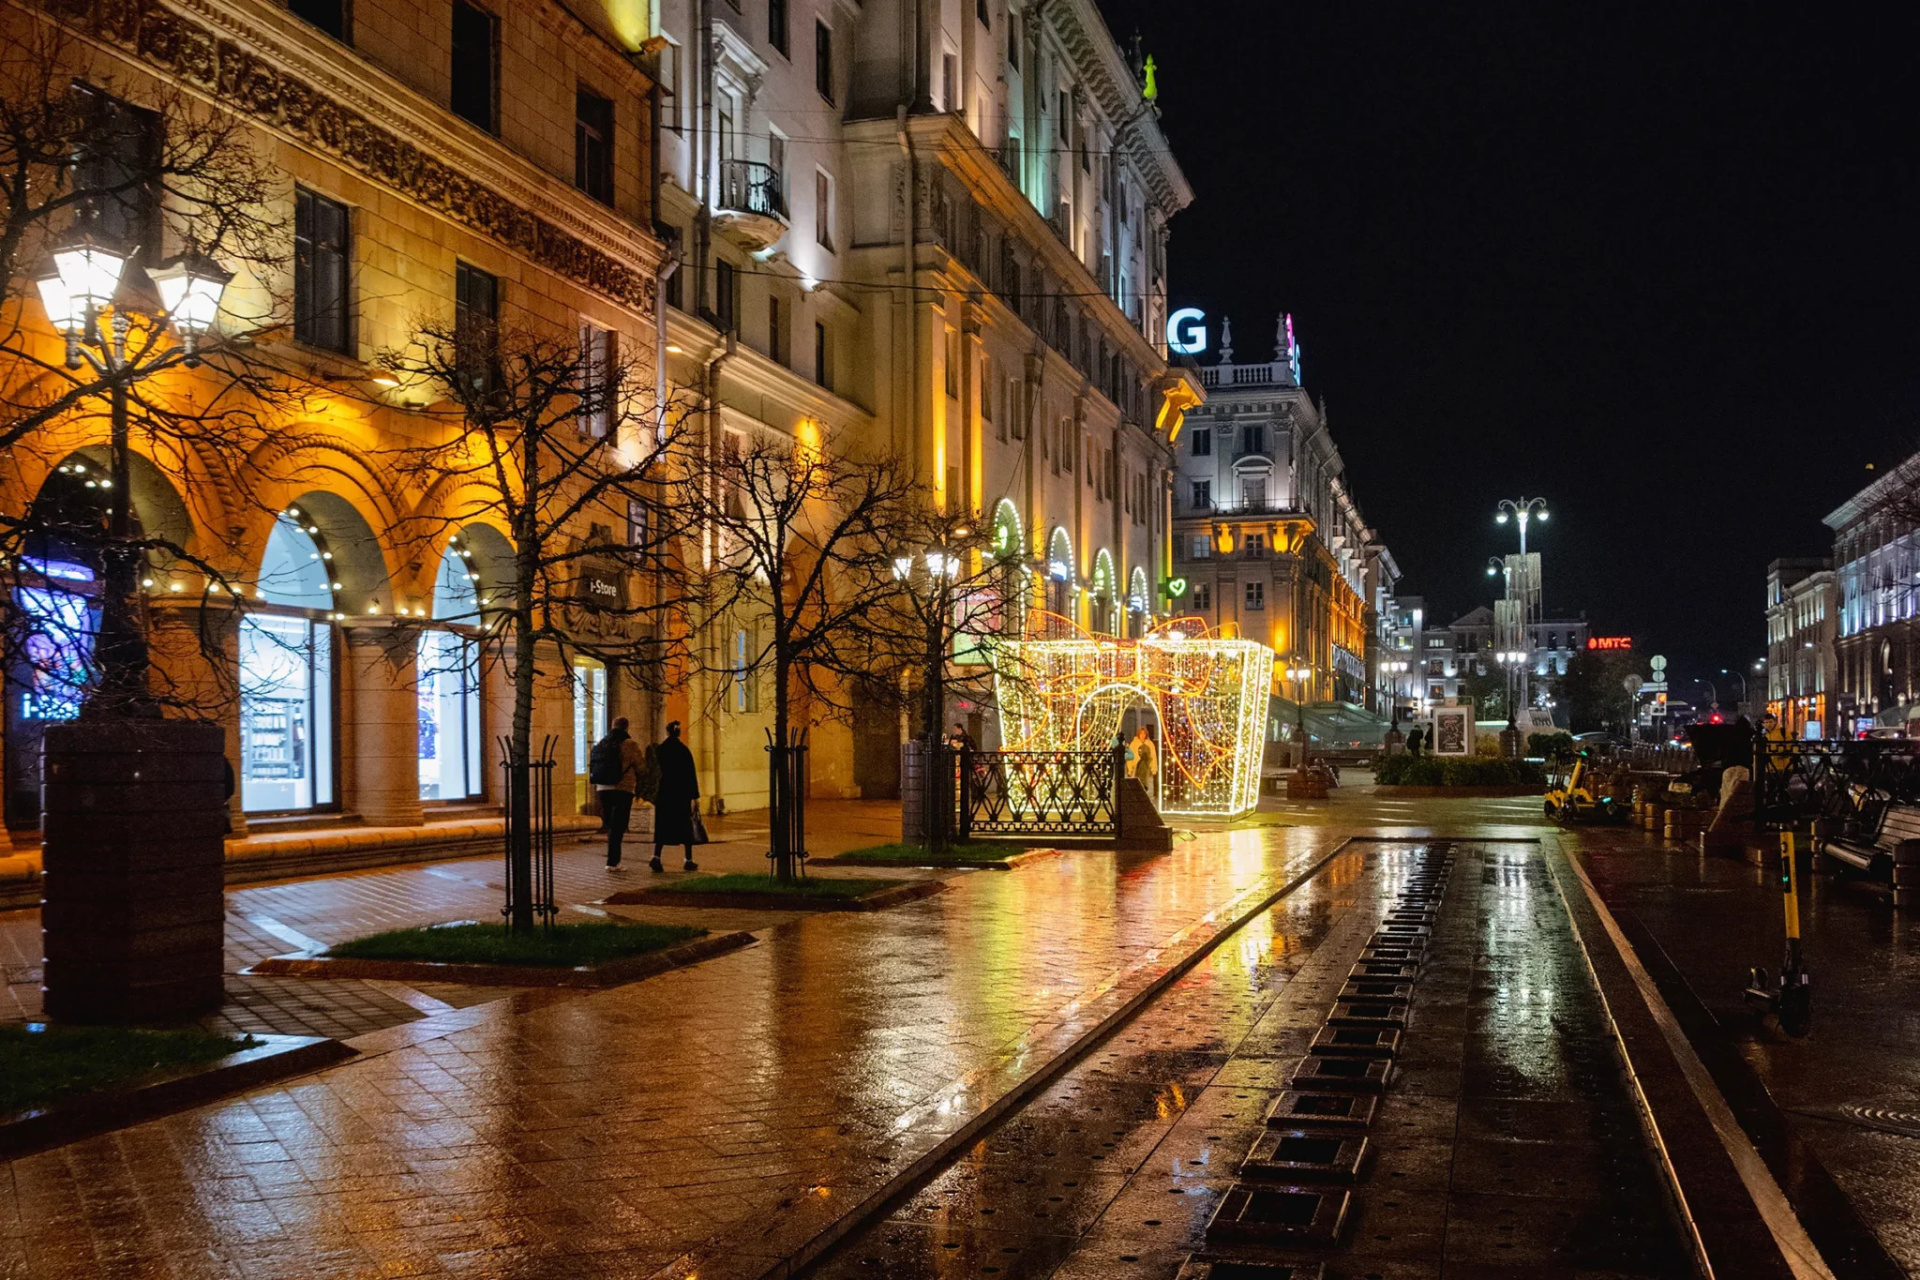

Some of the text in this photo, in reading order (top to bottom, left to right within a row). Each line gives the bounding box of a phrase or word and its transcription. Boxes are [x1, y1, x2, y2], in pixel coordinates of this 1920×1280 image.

[1166, 307, 1206, 354] G
[590, 578, 617, 597] i-Store
[1598, 637, 1631, 649] МТС
